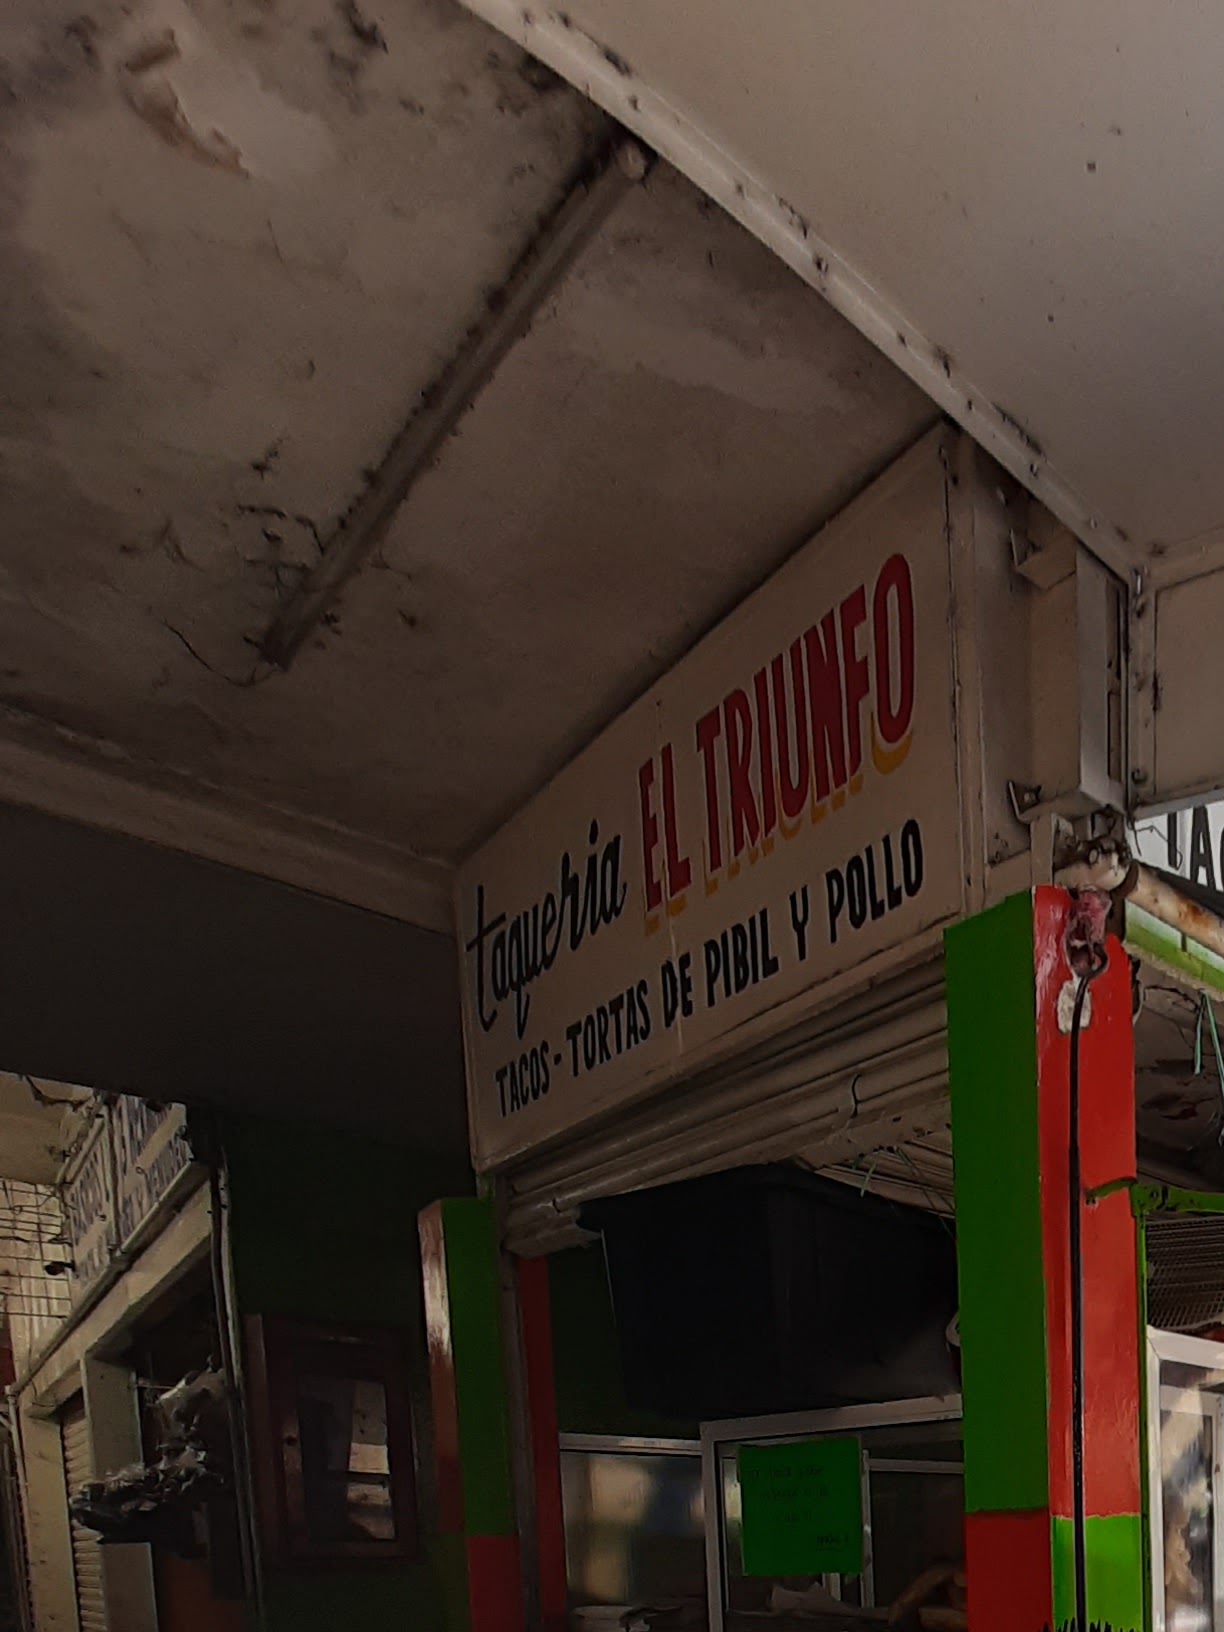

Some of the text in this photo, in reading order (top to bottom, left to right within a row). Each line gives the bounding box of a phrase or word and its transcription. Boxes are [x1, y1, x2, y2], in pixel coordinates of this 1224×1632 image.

[638, 742, 692, 911] EL
[696, 553, 915, 872] TRIUNFO
[495, 1040, 550, 1117] TACOS
[566, 979, 651, 1077] TORTAS
[661, 952, 693, 1027] DE
[704, 908, 779, 1008] PIBIL
[789, 884, 809, 961] Y
[826, 819, 923, 944] POLLO
